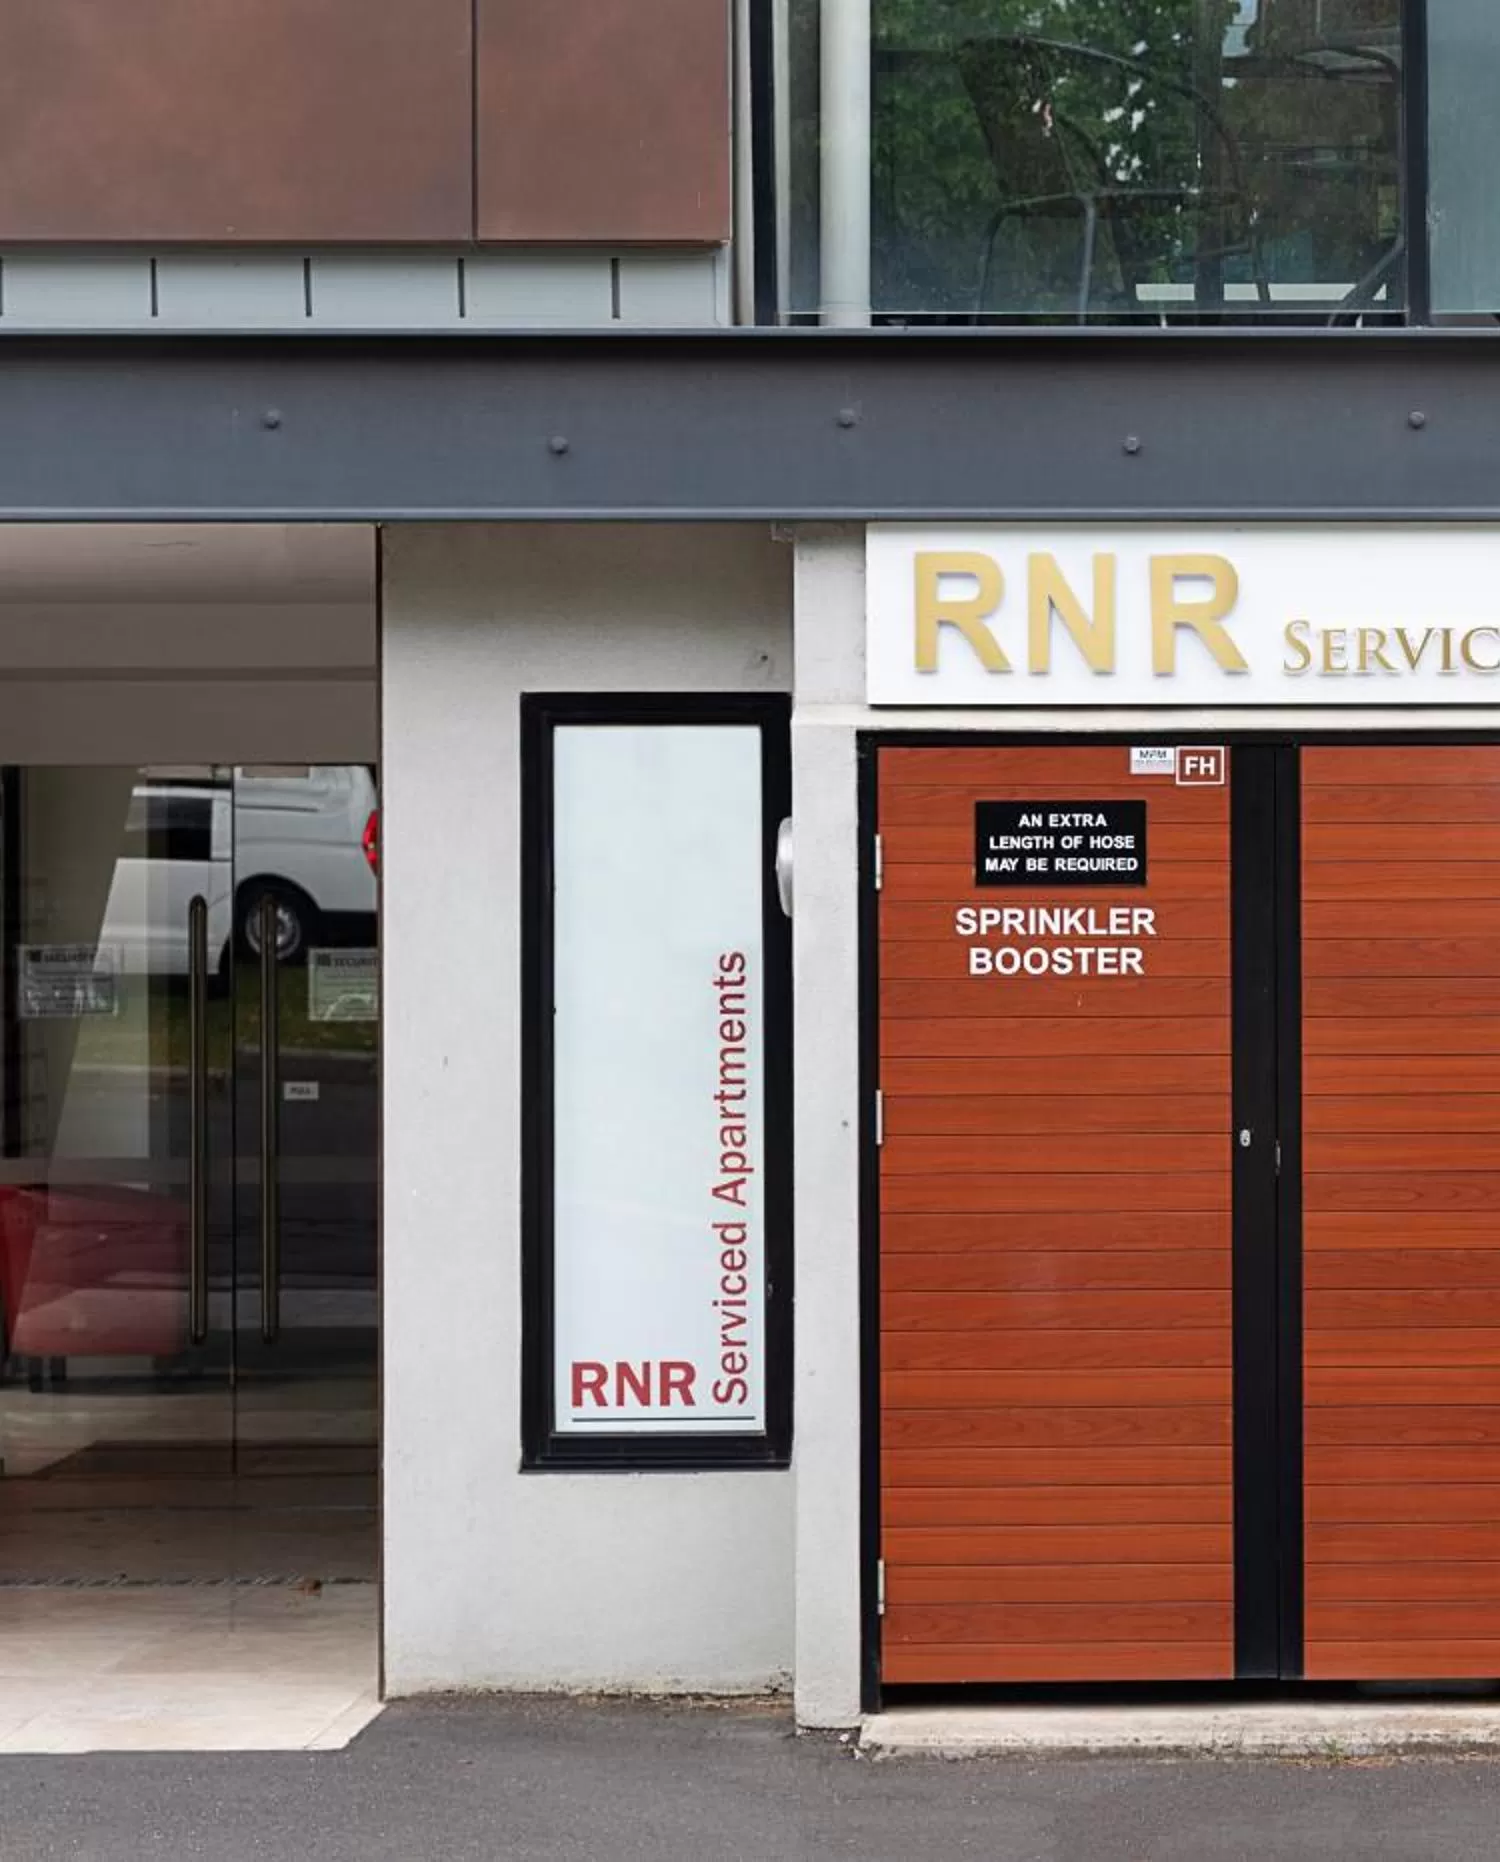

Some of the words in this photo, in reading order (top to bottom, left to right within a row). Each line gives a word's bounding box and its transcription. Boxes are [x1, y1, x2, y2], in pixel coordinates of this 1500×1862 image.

[913, 550, 1250, 675] RNR
[1184, 755, 1216, 776] FH
[1018, 813, 1043, 828] AN
[1048, 813, 1108, 828] EXTRA
[989, 835, 1055, 850] LENGTH
[1060, 835, 1083, 850] OF
[1089, 835, 1135, 850] HOSE
[984, 857, 1019, 872] MAY
[1025, 857, 1049, 872] BE
[1054, 857, 1139, 873] REQUIRED
[955, 907, 1157, 936] SPRINKLER
[969, 946, 1145, 976] BOOSTER
[711, 949, 755, 1206] Apartments
[711, 1222, 749, 1406] Serviced
[571, 1360, 697, 1408] RNR
